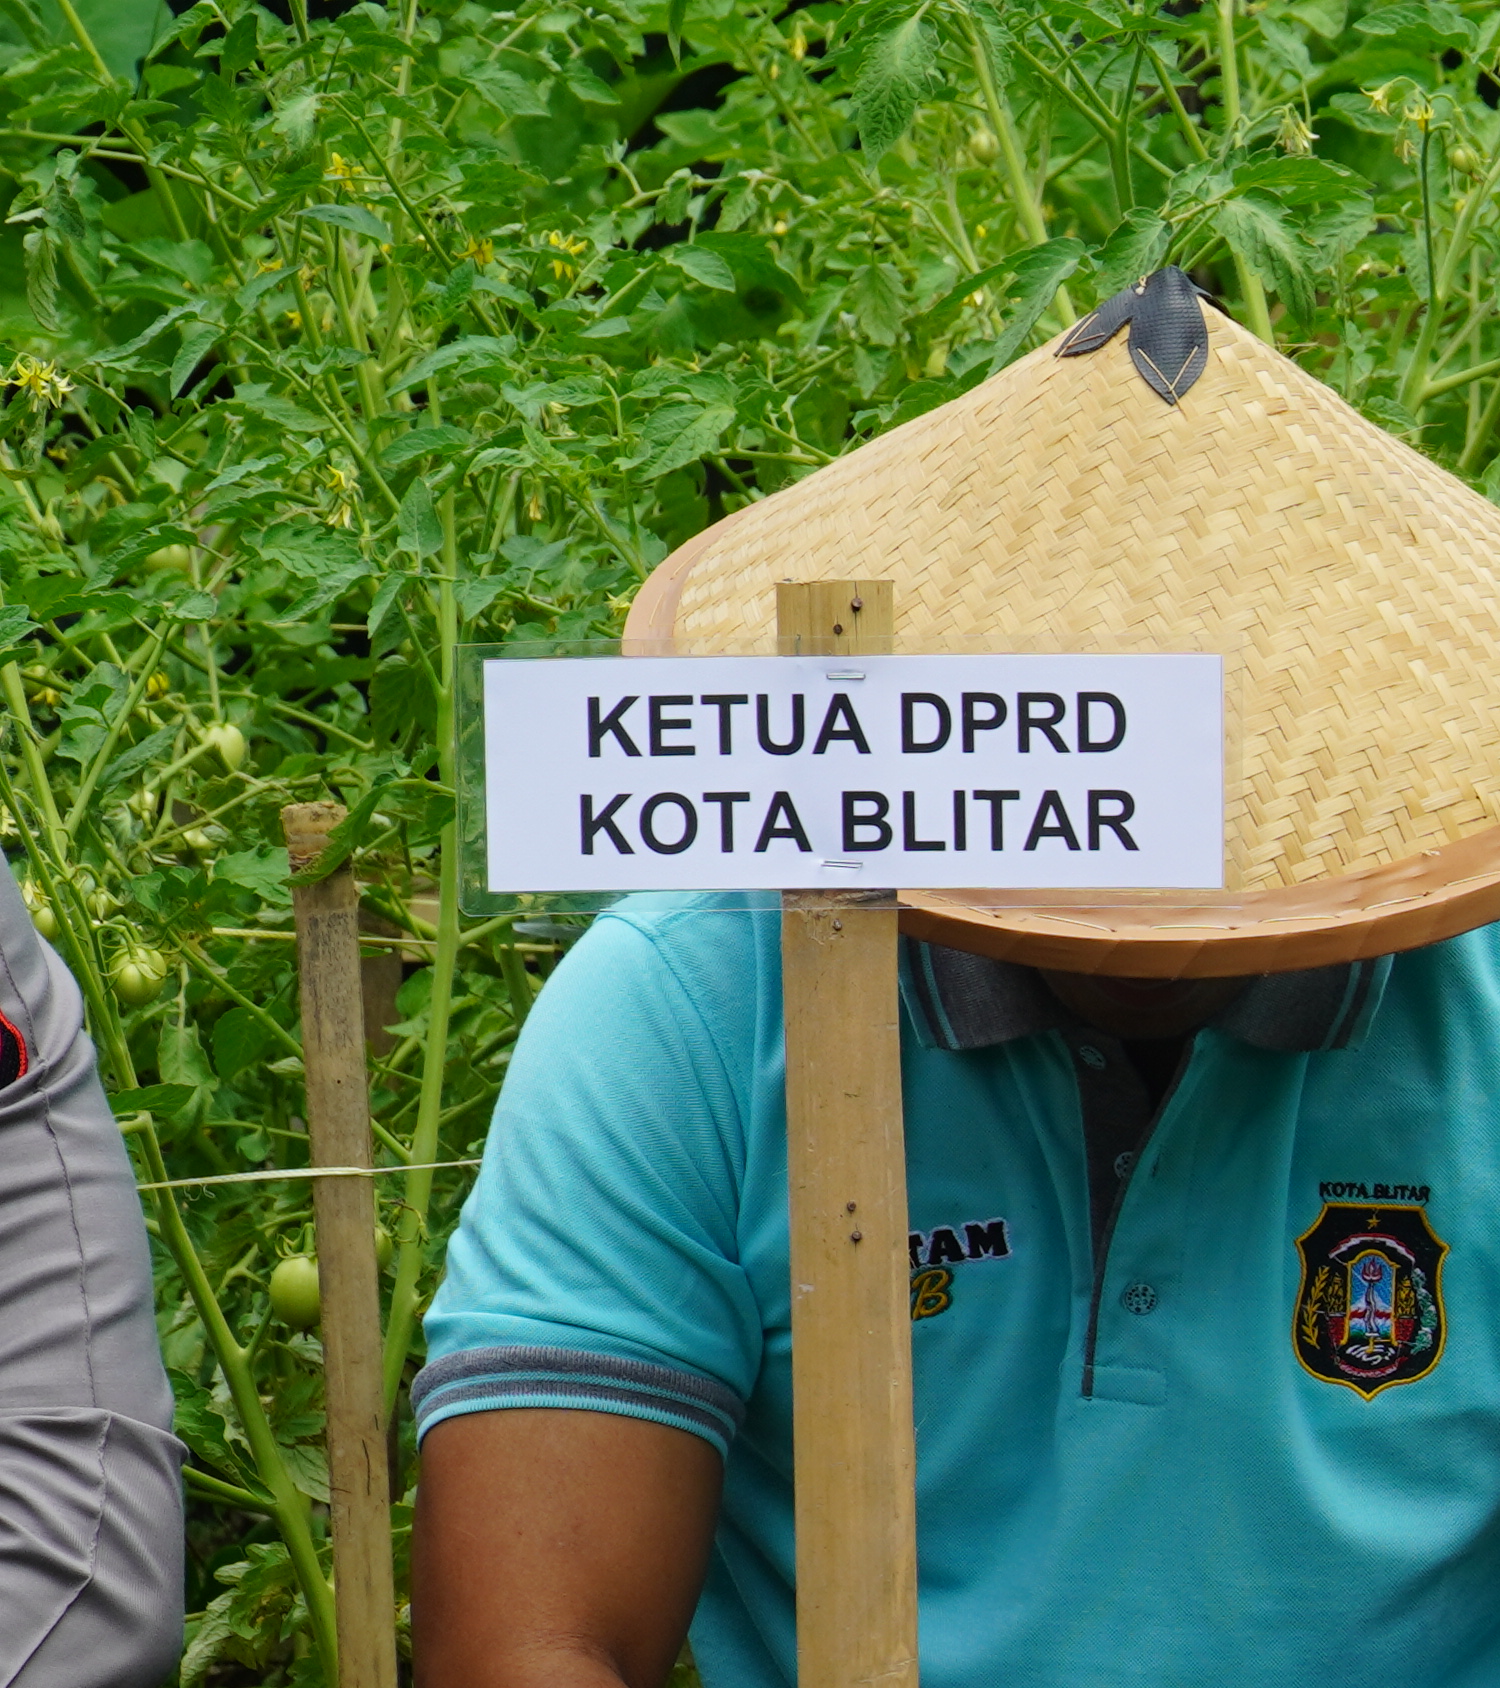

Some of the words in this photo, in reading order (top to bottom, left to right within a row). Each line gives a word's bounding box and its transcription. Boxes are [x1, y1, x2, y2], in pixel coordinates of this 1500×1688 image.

[586, 692, 873, 759] KETUA
[899, 690, 1128, 755] DPRD
[579, 791, 814, 857] KOTA
[840, 788, 1141, 855] BLITAR
[1319, 1182, 1368, 1199] KOTA
[1373, 1183, 1431, 1201] BLITAR
